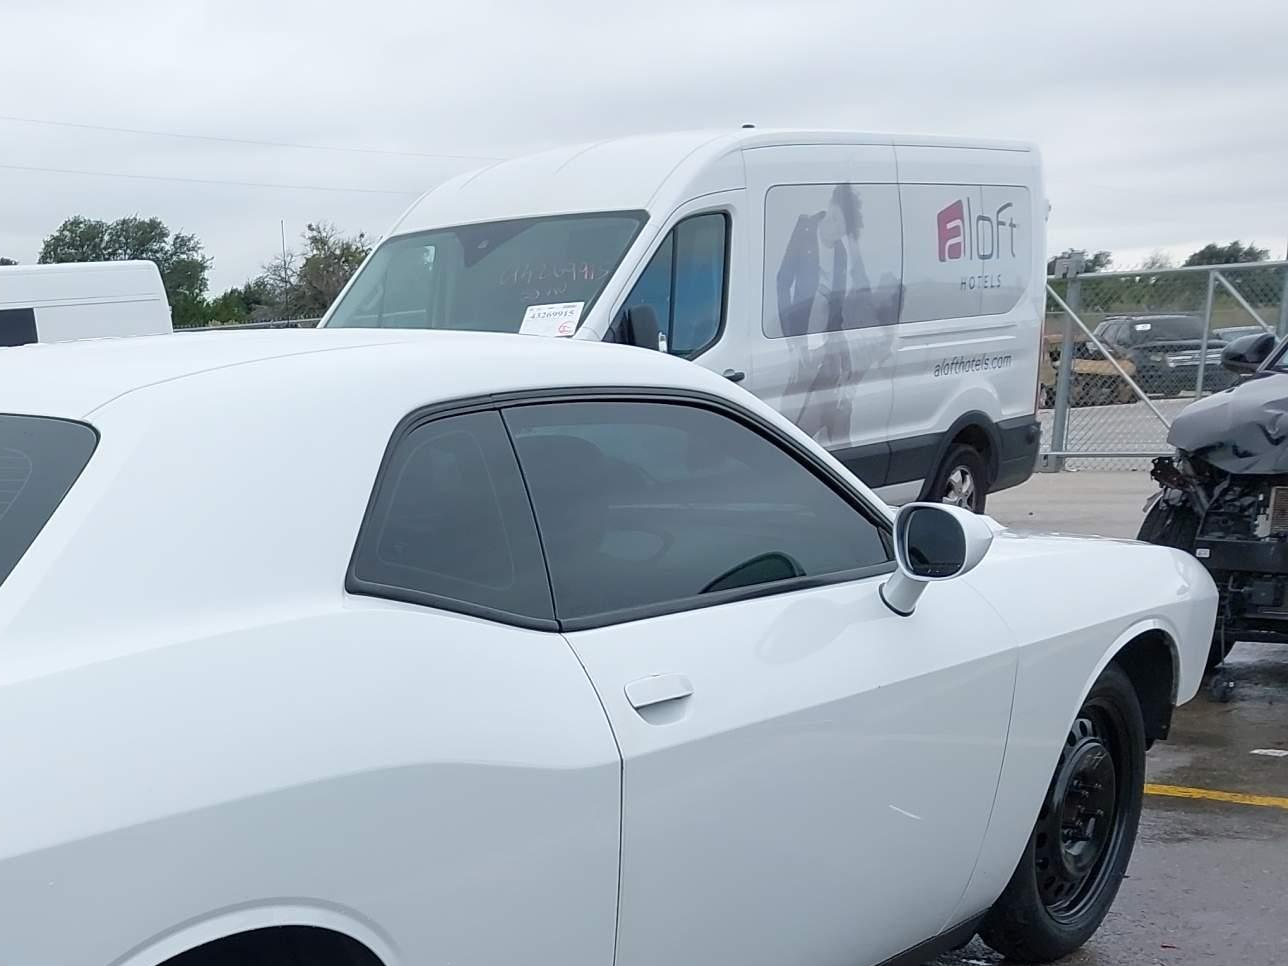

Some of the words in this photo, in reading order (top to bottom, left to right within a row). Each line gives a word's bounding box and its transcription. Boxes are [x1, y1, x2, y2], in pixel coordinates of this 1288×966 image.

[937, 197, 1017, 262] aloft
[960, 274, 1002, 290] HOTELS
[934, 353, 1012, 377] alofthotels.com
